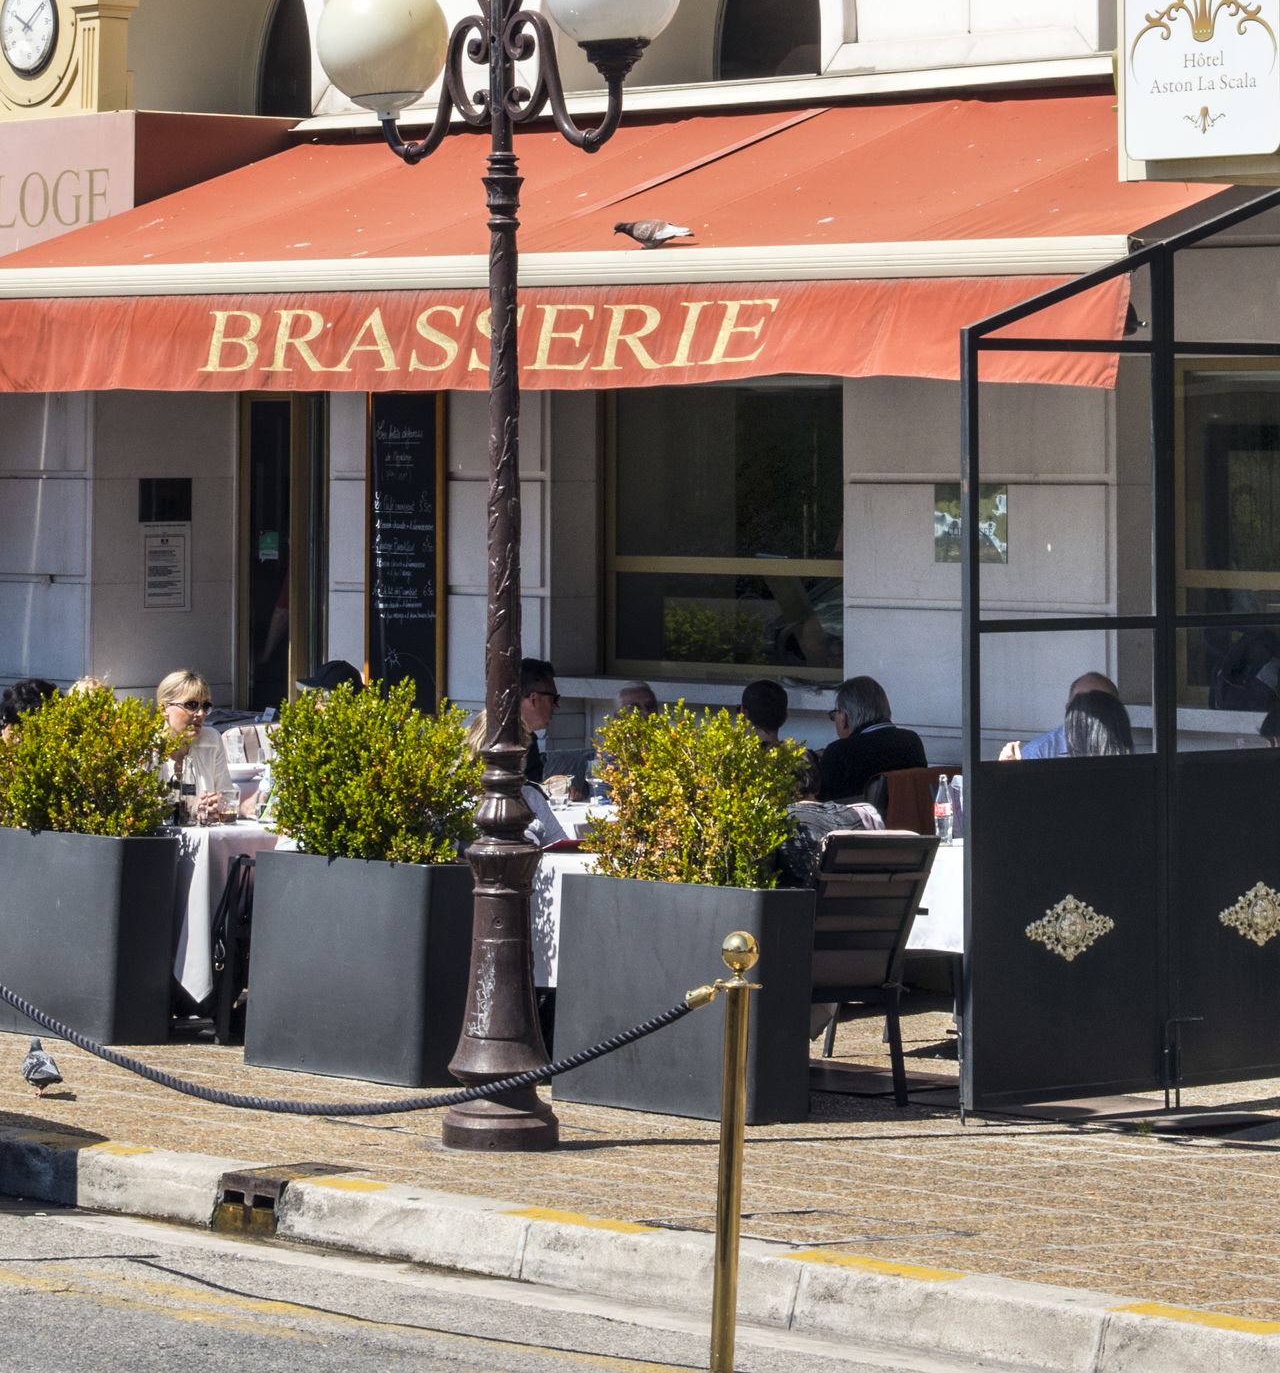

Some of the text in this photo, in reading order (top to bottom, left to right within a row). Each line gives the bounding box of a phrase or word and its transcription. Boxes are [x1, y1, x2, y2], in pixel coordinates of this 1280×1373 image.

[1183, 49, 1225, 69] Hôtel
[1149, 71, 1257, 94] Aston La Scala
